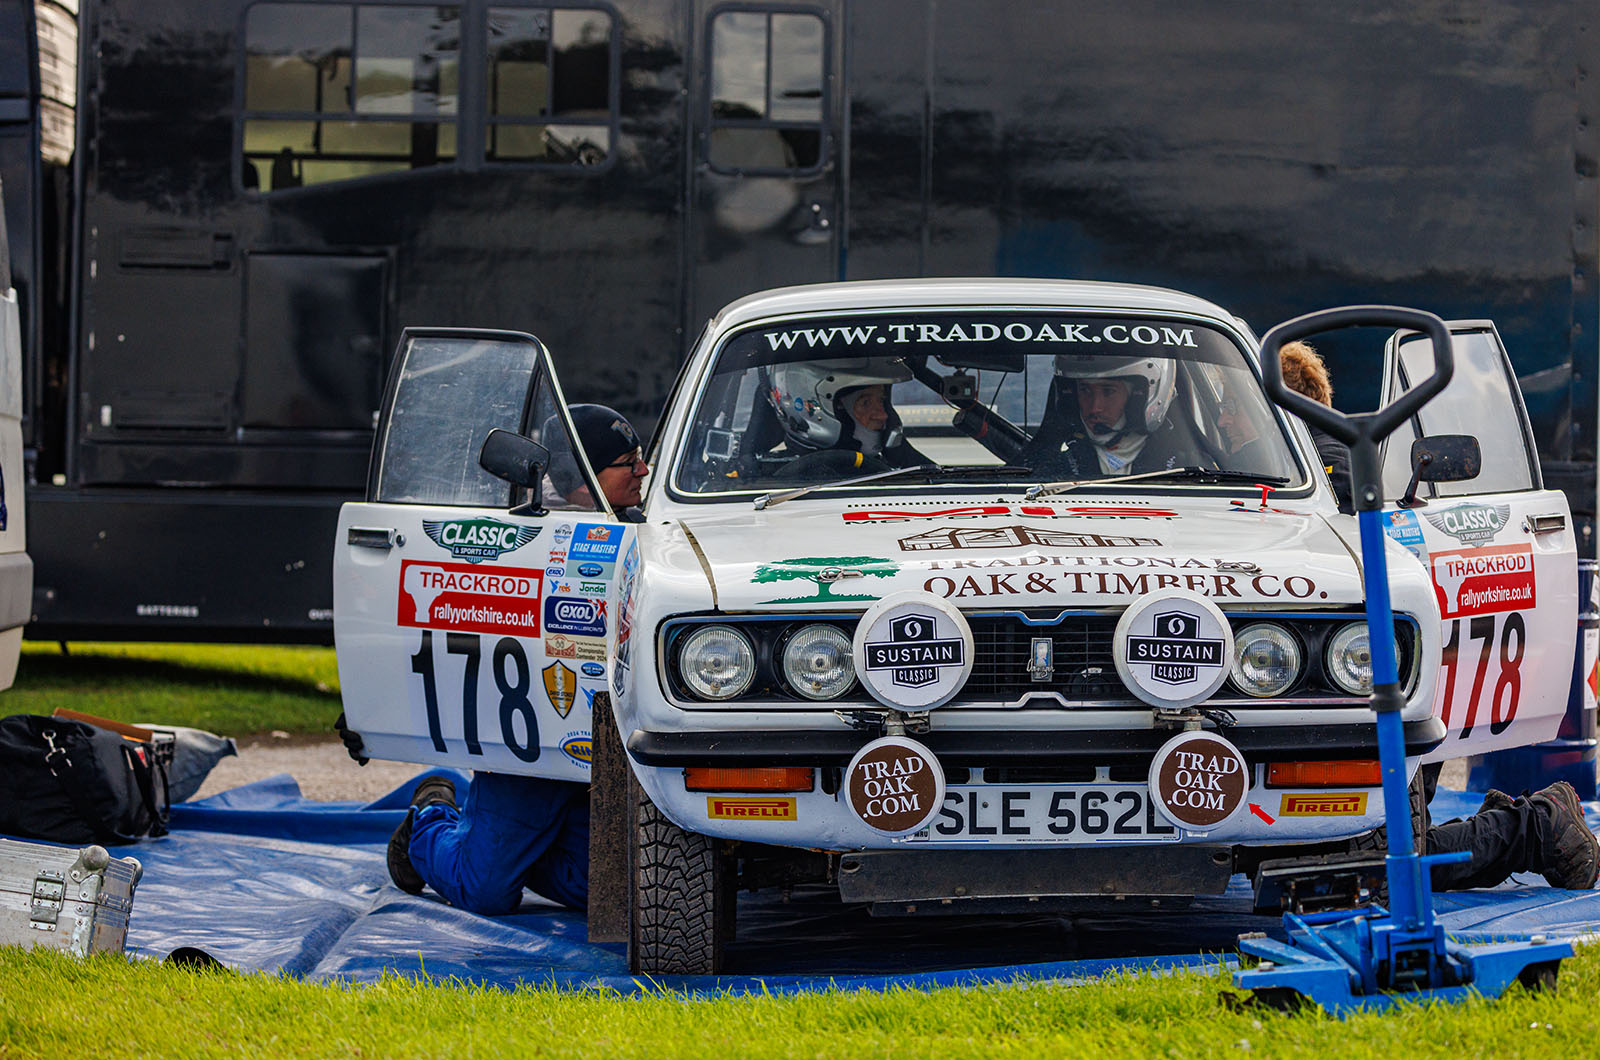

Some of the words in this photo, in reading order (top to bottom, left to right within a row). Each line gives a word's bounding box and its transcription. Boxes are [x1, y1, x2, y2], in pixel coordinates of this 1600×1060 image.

[764, 323, 1199, 351] WWW.TRADOAK.COM
[1443, 507, 1500, 534] CLASSIC
[441, 523, 517, 549] CLASSIC
[460, 547, 482, 555] SPORTS
[483, 548, 497, 556] CAR
[572, 543, 591, 553] STAGE
[590, 544, 617, 555] MASTERS
[1445, 554, 1527, 578] TRACKROD
[420, 571, 531, 596] TRACKROD
[579, 581, 607, 593] Jondel
[923, 572, 1020, 598] OAK
[1024, 571, 1057, 594] &
[1063, 572, 1242, 598] TIMBER
[1251, 574, 1329, 599] CO.
[1460, 583, 1533, 608] rallyyorkshire.co.uk
[434, 603, 535, 627] rallyyorkshire.co.uk
[876, 646, 953, 664] SUSTAIN
[1137, 643, 1213, 660] SUSTAIN
[899, 668, 933, 682] CLASSIC
[1158, 665, 1192, 679] CLASSIC
[1441, 612, 1526, 740] 178
[411, 630, 541, 763] 178
[859, 756, 924, 781] TRAD
[1175, 751, 1239, 774] TRAD
[863, 775, 914, 798] OAK
[1174, 770, 1224, 791] OAK
[714, 801, 790, 817] PIRELLI
[862, 794, 922, 819] .COM
[1167, 789, 1226, 811] .COM
[1286, 796, 1361, 812] PIRELLI
[935, 791, 1031, 836] SLE
[1047, 791, 1175, 835] 562L
